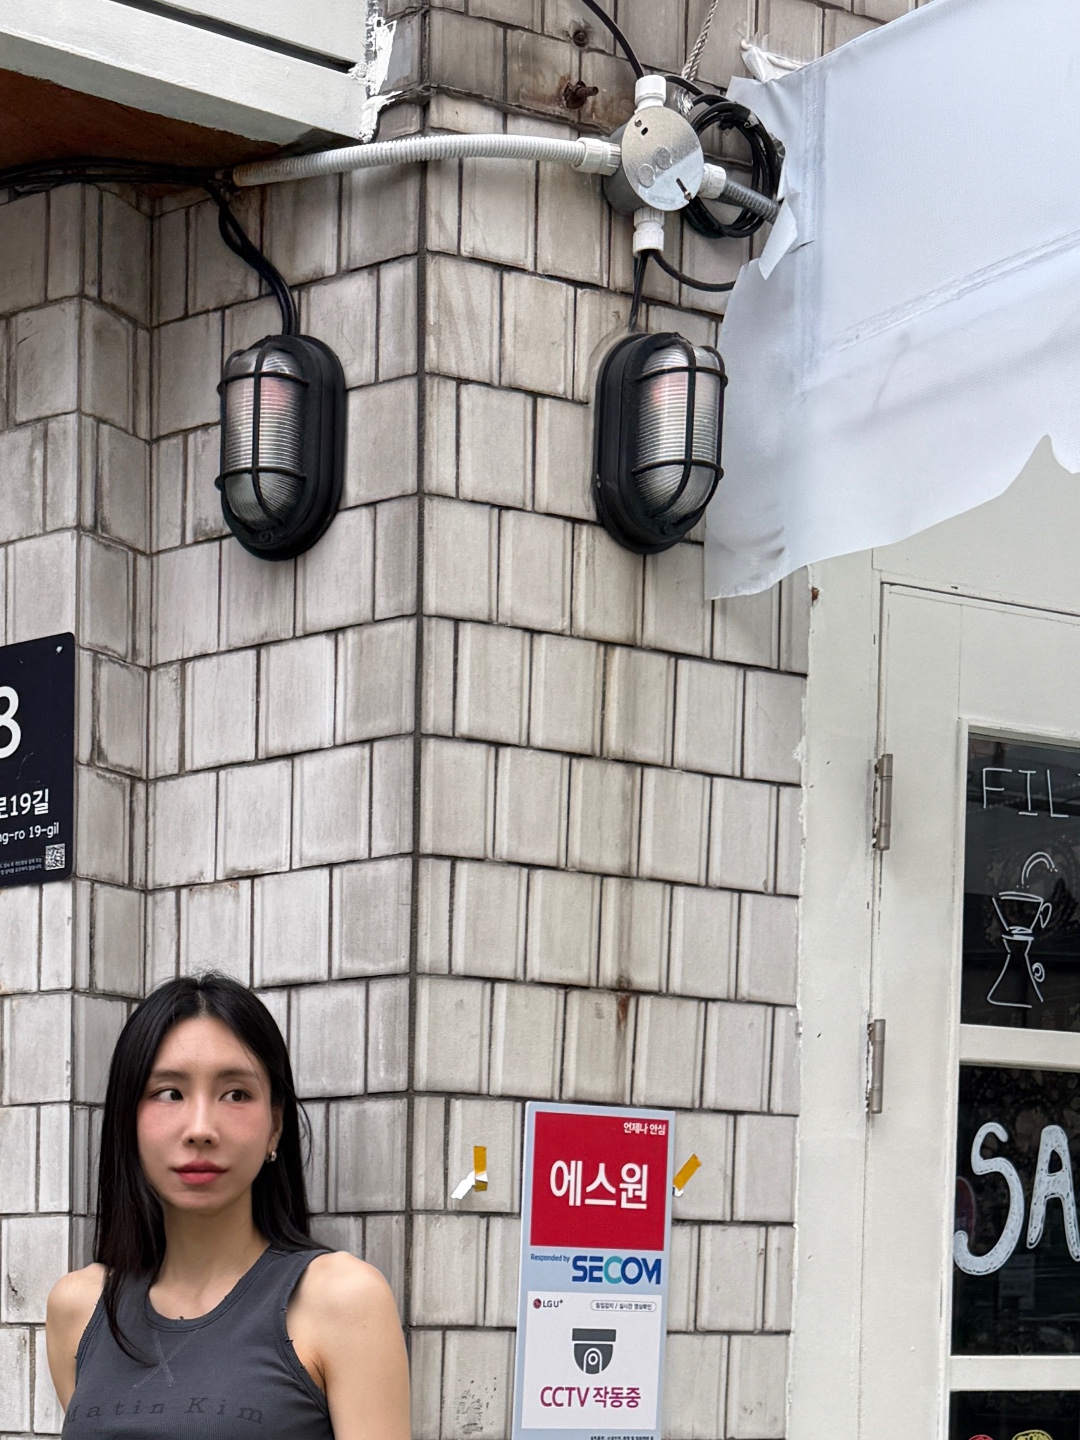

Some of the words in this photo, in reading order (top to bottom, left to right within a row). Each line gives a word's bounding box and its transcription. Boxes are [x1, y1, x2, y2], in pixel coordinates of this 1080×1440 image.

[983, 767, 1080, 818] FIL
[29, 822, 60, 839] 19-gil
[623, 1122, 649, 1135] 언제나
[649, 1123, 666, 1136] 안심
[550, 1160, 648, 1210] 에스원
[530, 1253, 562, 1262] Responded
[563, 1255, 570, 1263] by
[572, 1255, 662, 1285] SECOM
[184, 1397, 265, 1425] Kim
[540, 1386, 590, 1408] CCTV
[593, 1386, 642, 1409] 작동중
